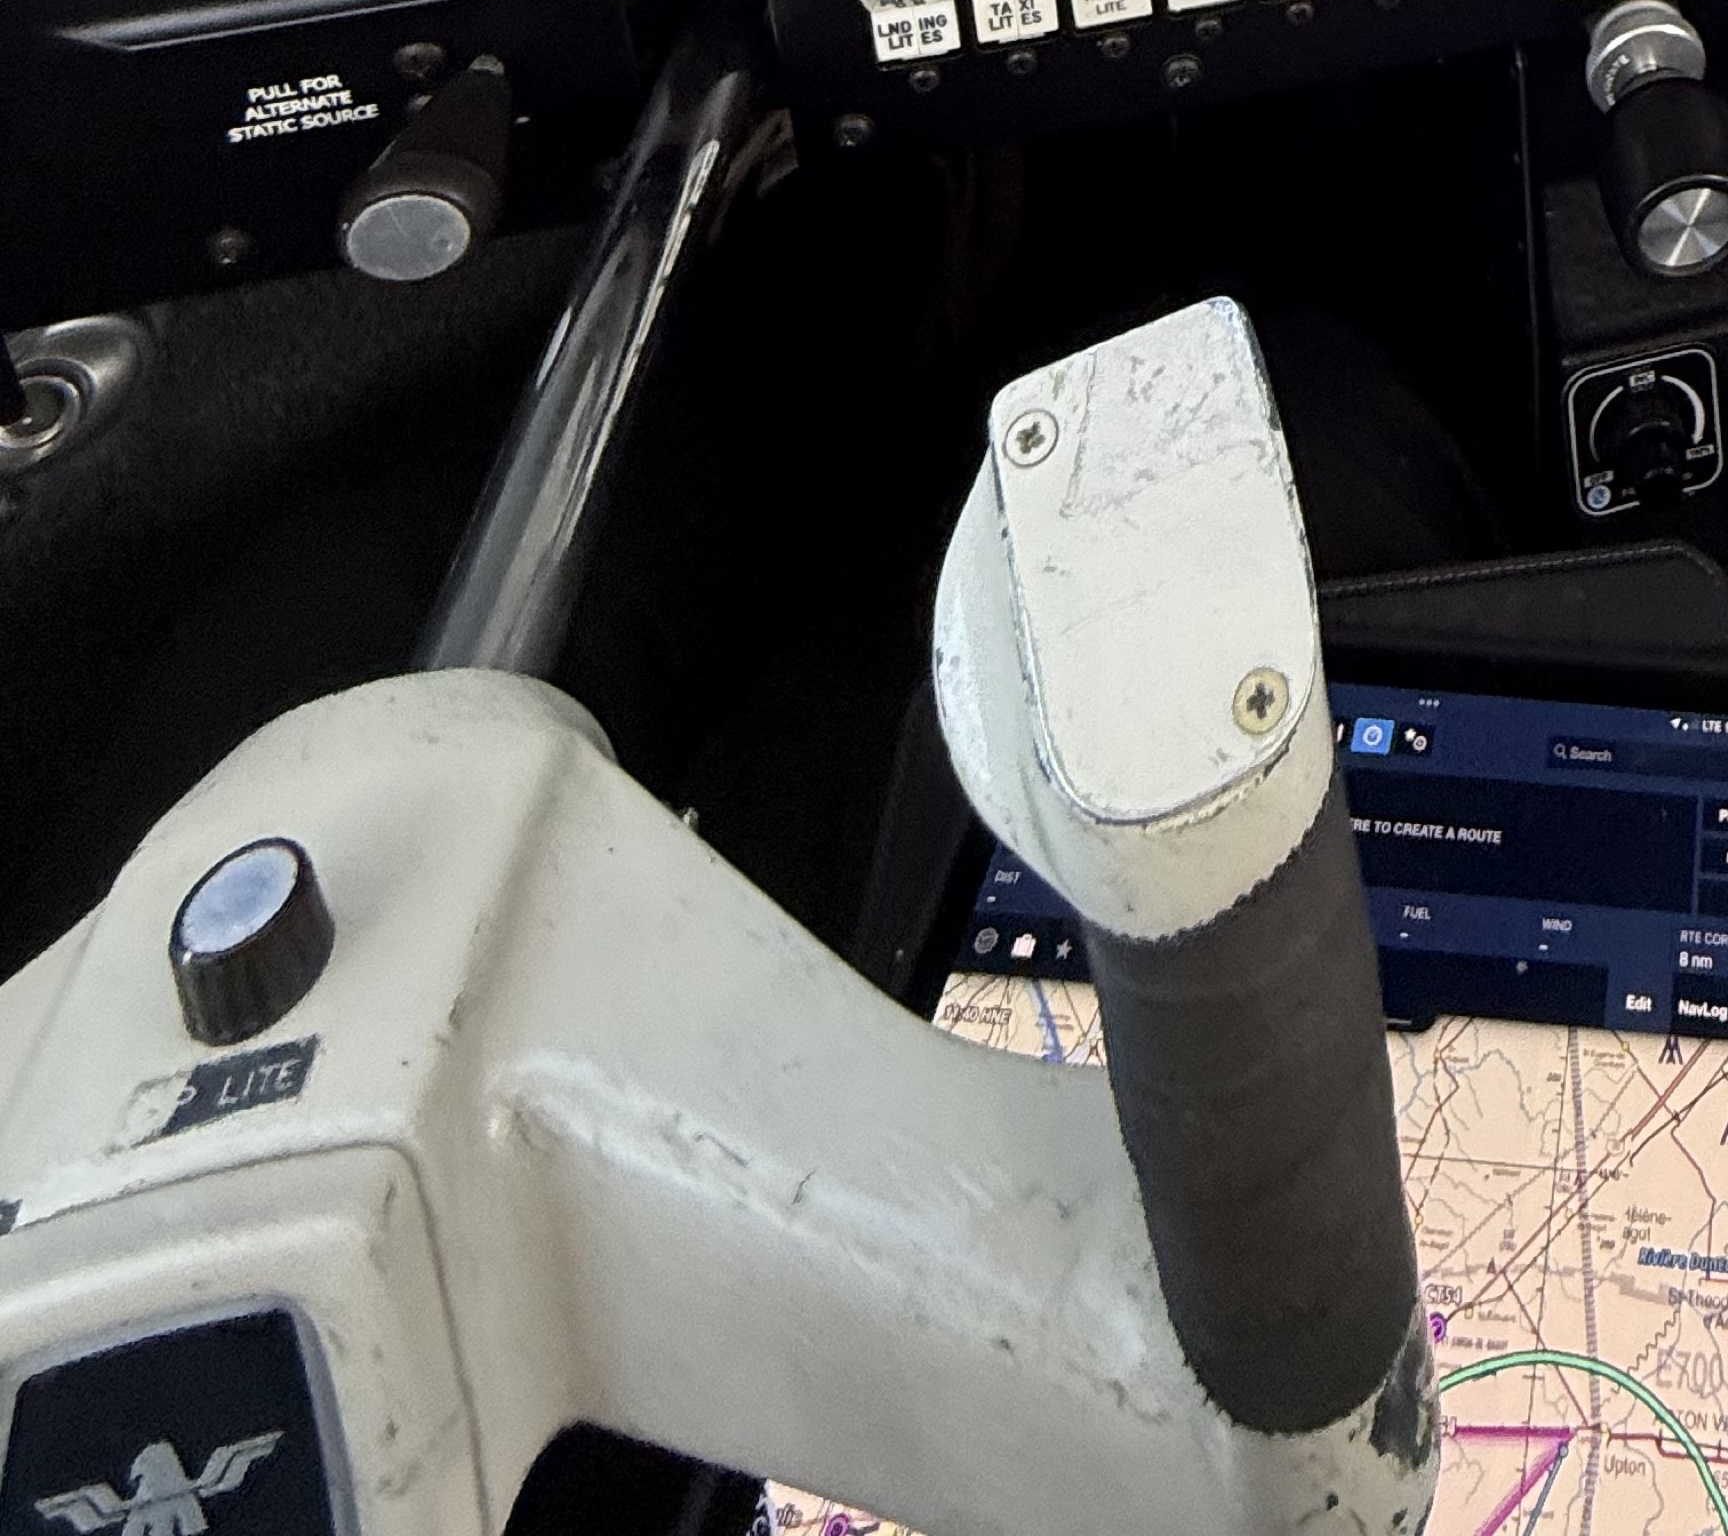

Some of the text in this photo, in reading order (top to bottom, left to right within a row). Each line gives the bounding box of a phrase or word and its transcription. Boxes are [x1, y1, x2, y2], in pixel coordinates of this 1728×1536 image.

[248, 74, 341, 102] PULL FOR
[245, 89, 353, 122] ALTERNATE
[228, 104, 378, 143] STATIC SOURCE
[1394, 820, 1502, 843] CREATE ROUTE
[1678, 1002, 1728, 1021] NavLog
[216, 1064, 298, 1105] LITE
[1604, 1458, 1645, 1476] Upton
